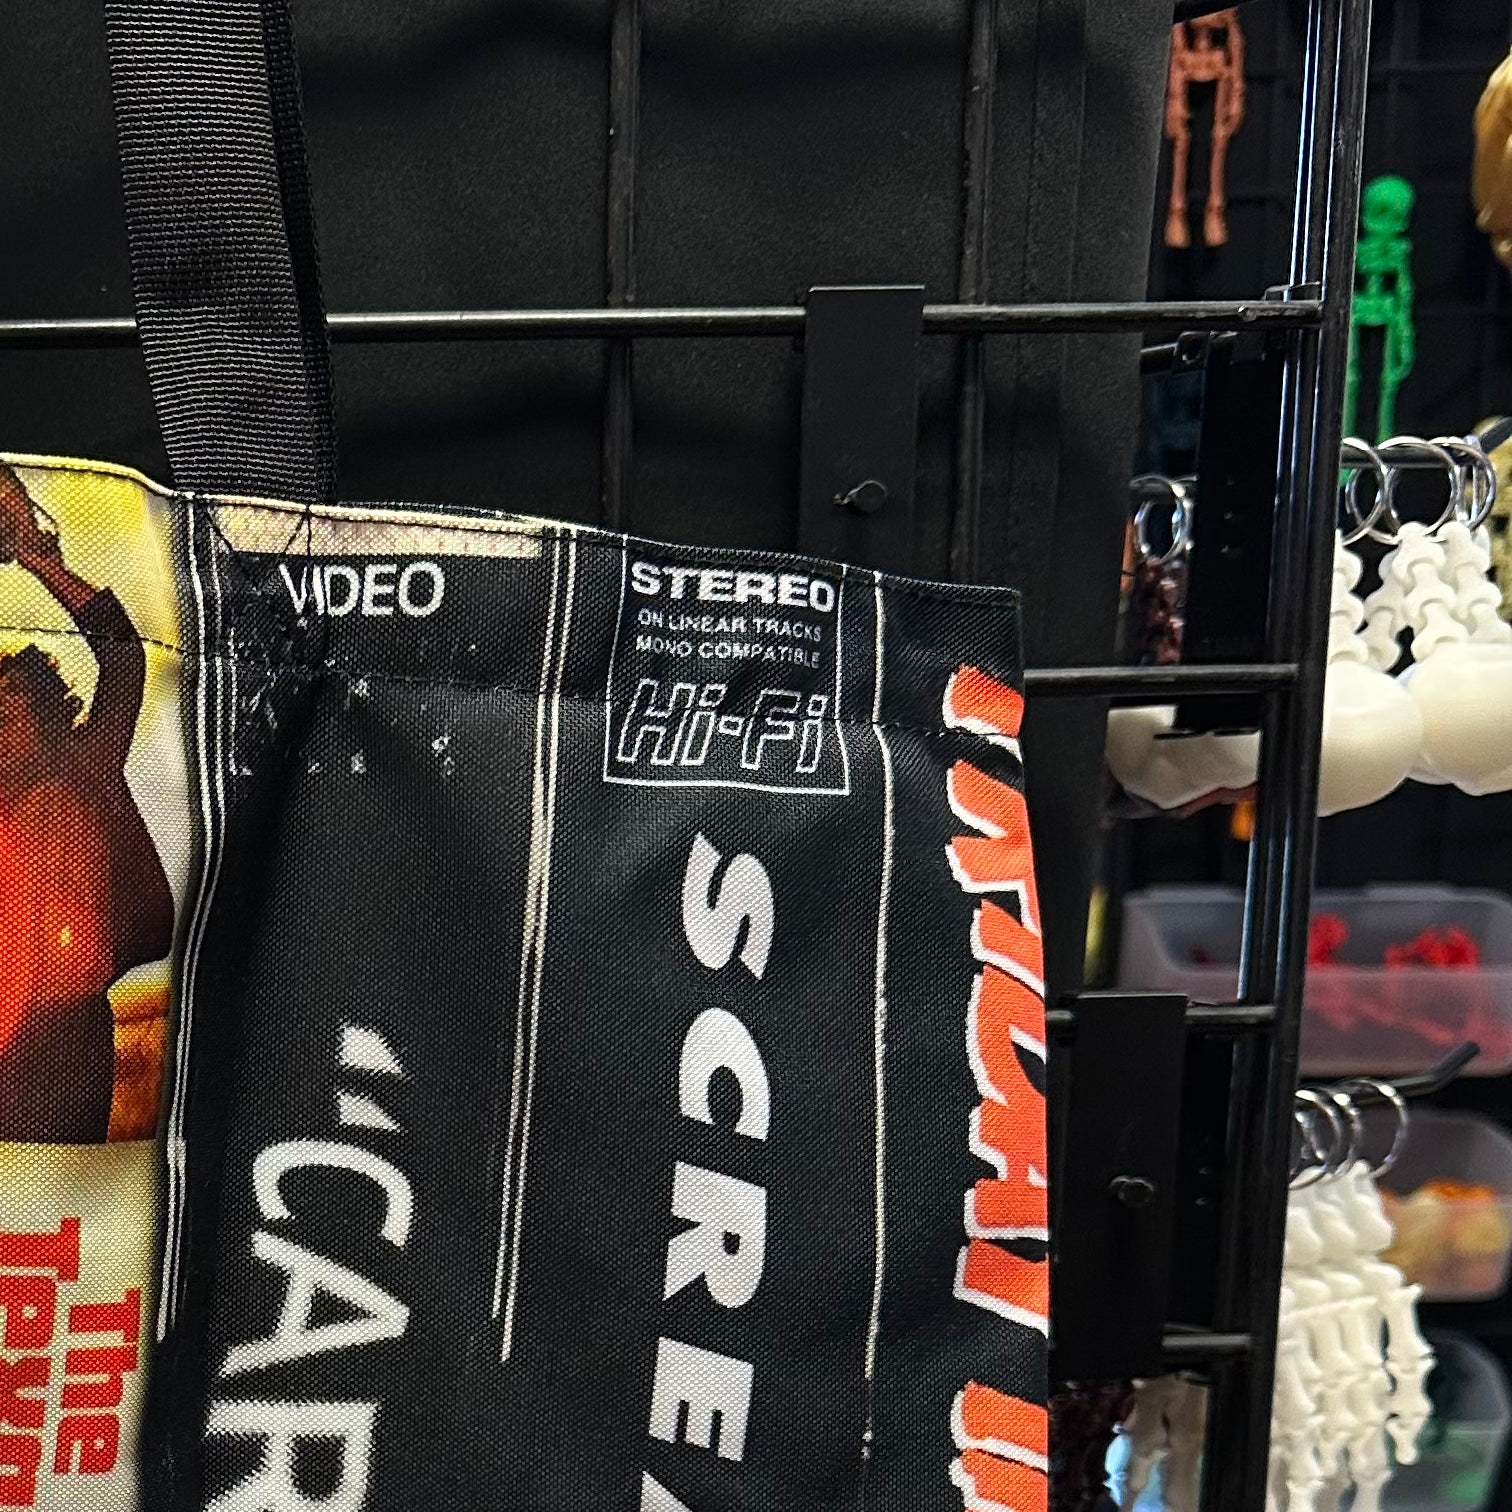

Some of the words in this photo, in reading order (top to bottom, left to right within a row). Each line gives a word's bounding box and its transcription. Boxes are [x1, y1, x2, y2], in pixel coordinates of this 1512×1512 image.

[278, 560, 446, 618] VIDEO
[630, 561, 836, 613] STEREO
[635, 635, 693, 658] MONO
[698, 641, 821, 669] COMPATIBLE
[637, 608, 664, 628] ON
[669, 613, 748, 633] LINEAR
[753, 618, 822, 642] TRACKS
[615, 677, 829, 774] Hi-Fi
[52, 1286, 141, 1478] The
